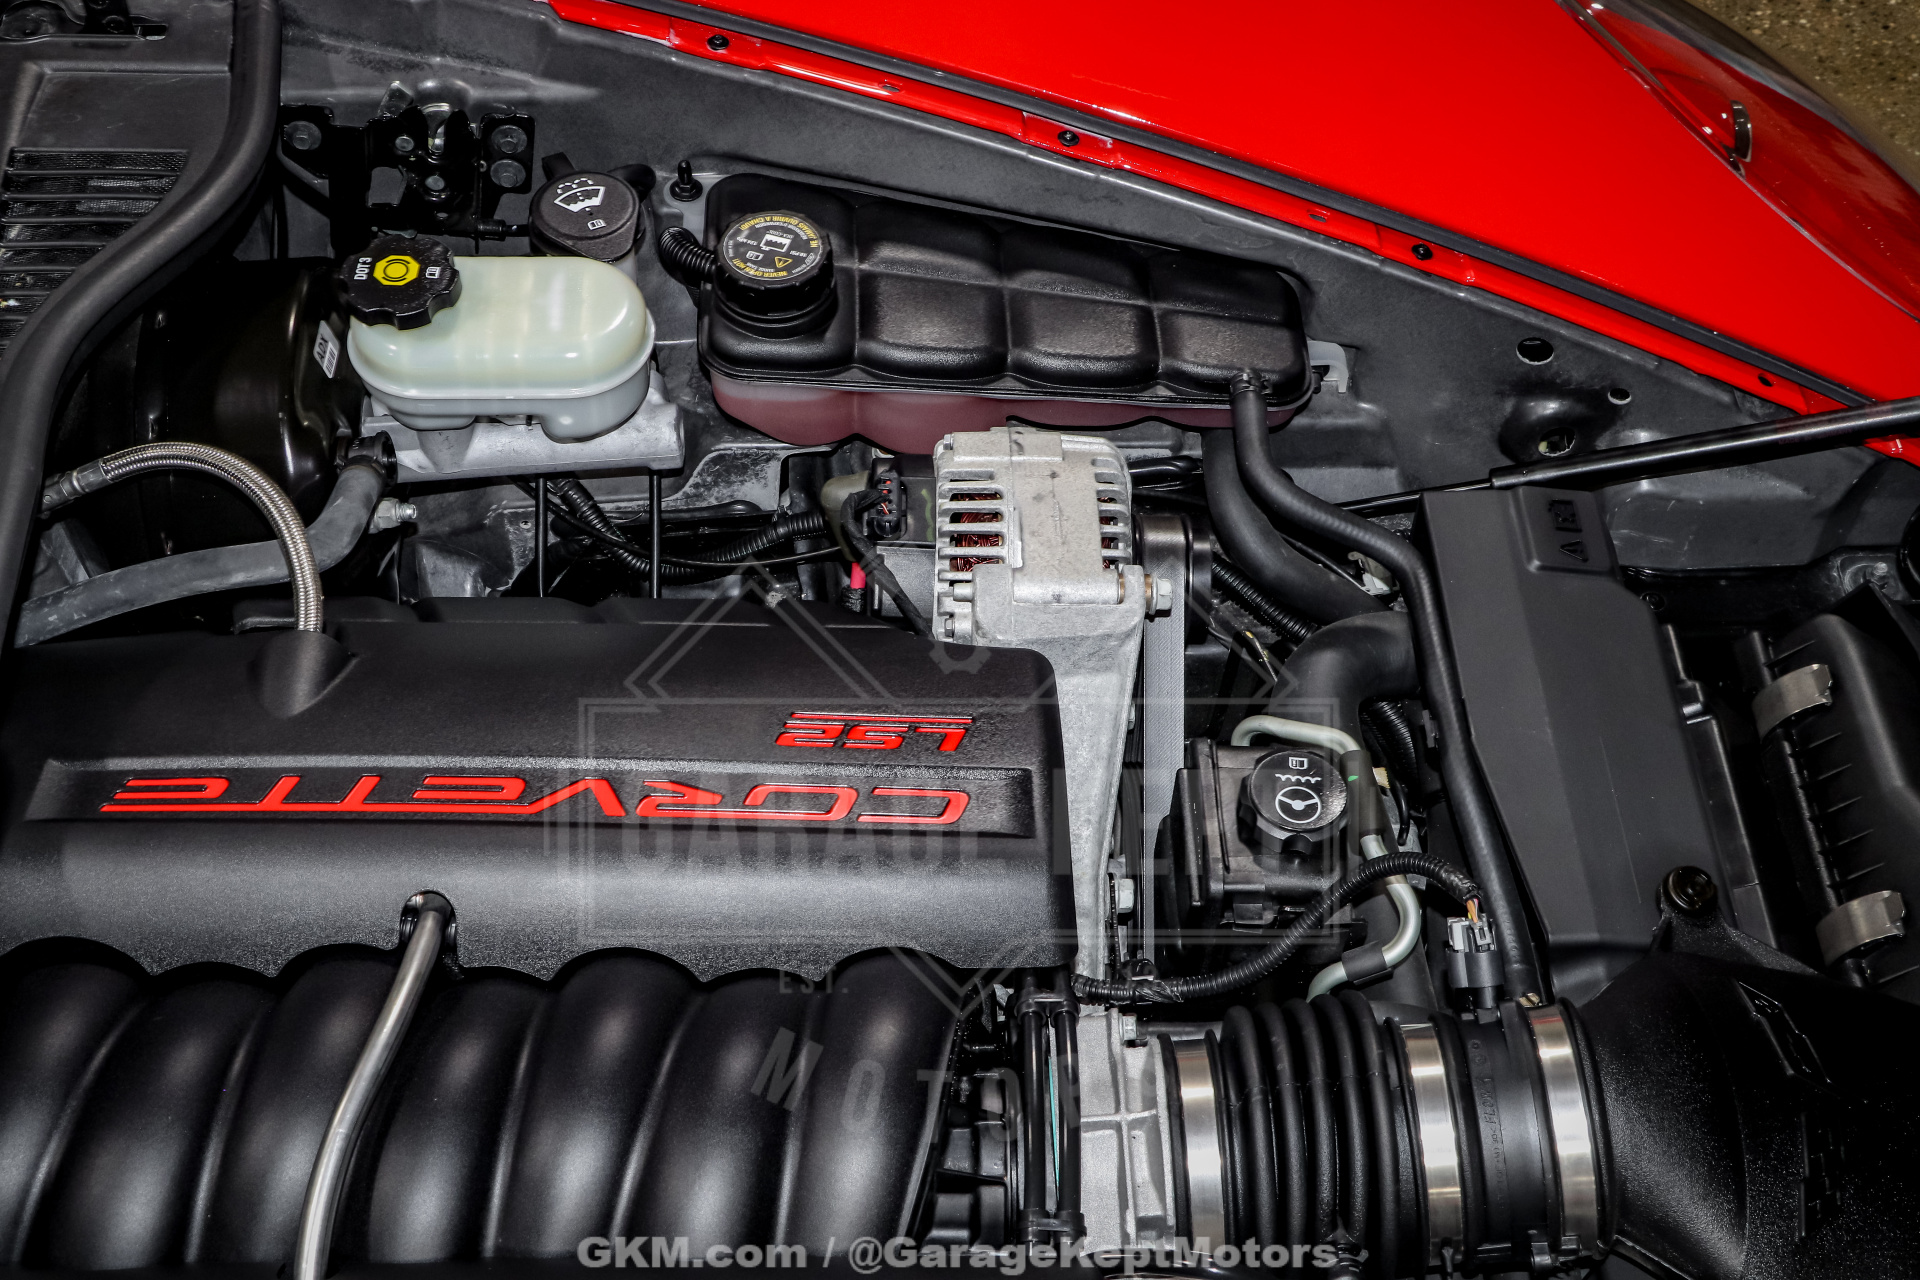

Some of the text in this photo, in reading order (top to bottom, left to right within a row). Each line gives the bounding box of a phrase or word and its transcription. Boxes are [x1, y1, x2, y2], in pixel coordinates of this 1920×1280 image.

[354, 263, 370, 280] DOT
[745, 267, 763, 277] OPEN
[775, 720, 968, 752] LS2
[99, 774, 971, 825] CORVETTE
